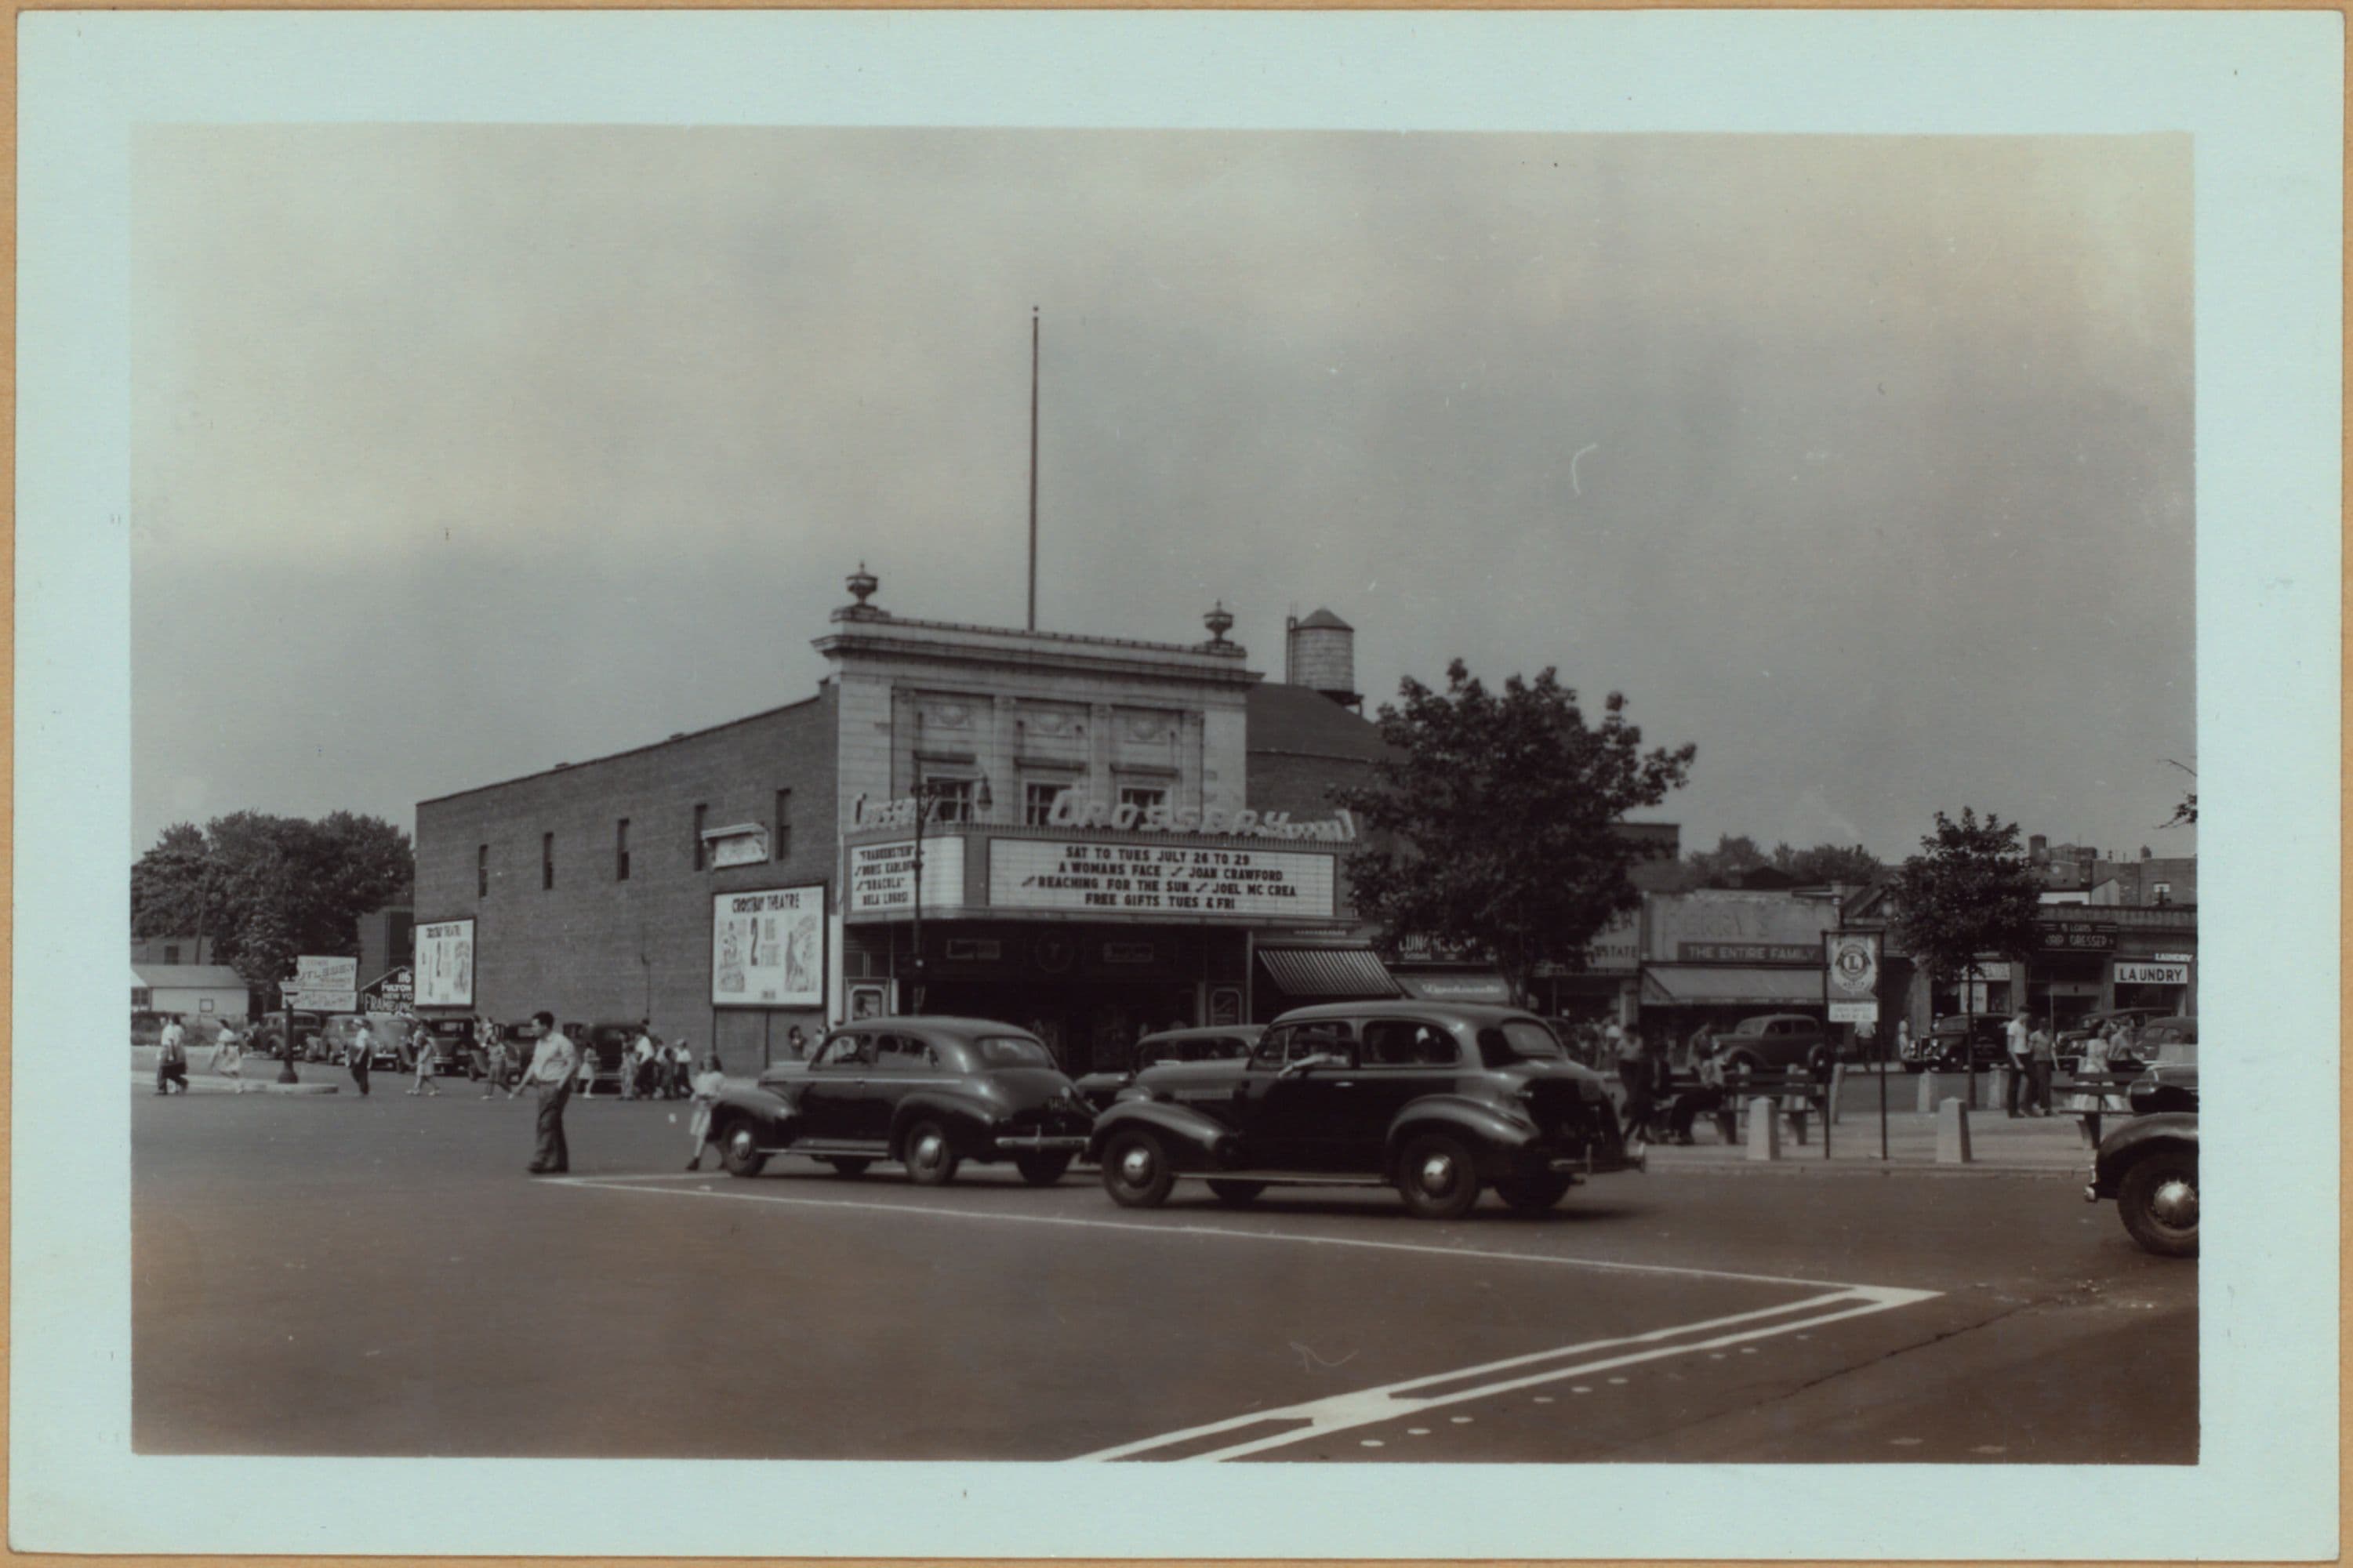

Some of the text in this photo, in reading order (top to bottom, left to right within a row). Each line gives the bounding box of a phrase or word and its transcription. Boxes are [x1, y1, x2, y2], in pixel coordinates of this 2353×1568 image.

[1066, 846, 1250, 866] SAT TO TUES JULY 26 TO 29
[885, 861, 914, 874] KARLOF
[1058, 861, 1284, 882] A WOMANS FACE JOAN CRAWFORD
[1038, 876, 1098, 889] REACHING
[1107, 879, 1131, 891] FOR
[1137, 880, 1160, 892] THE
[1166, 880, 1189, 892] SUN
[1212, 883, 1241, 895] JOEL
[1267, 884, 1296, 897] CREA
[1085, 893, 1236, 910] FREE GIFTS TUES & FRI
[1687, 946, 1815, 960] THE ENTIRE FAMILY
[2155, 953, 2193, 963] LAUNDRY
[2119, 967, 2183, 982] LAUNDRY
